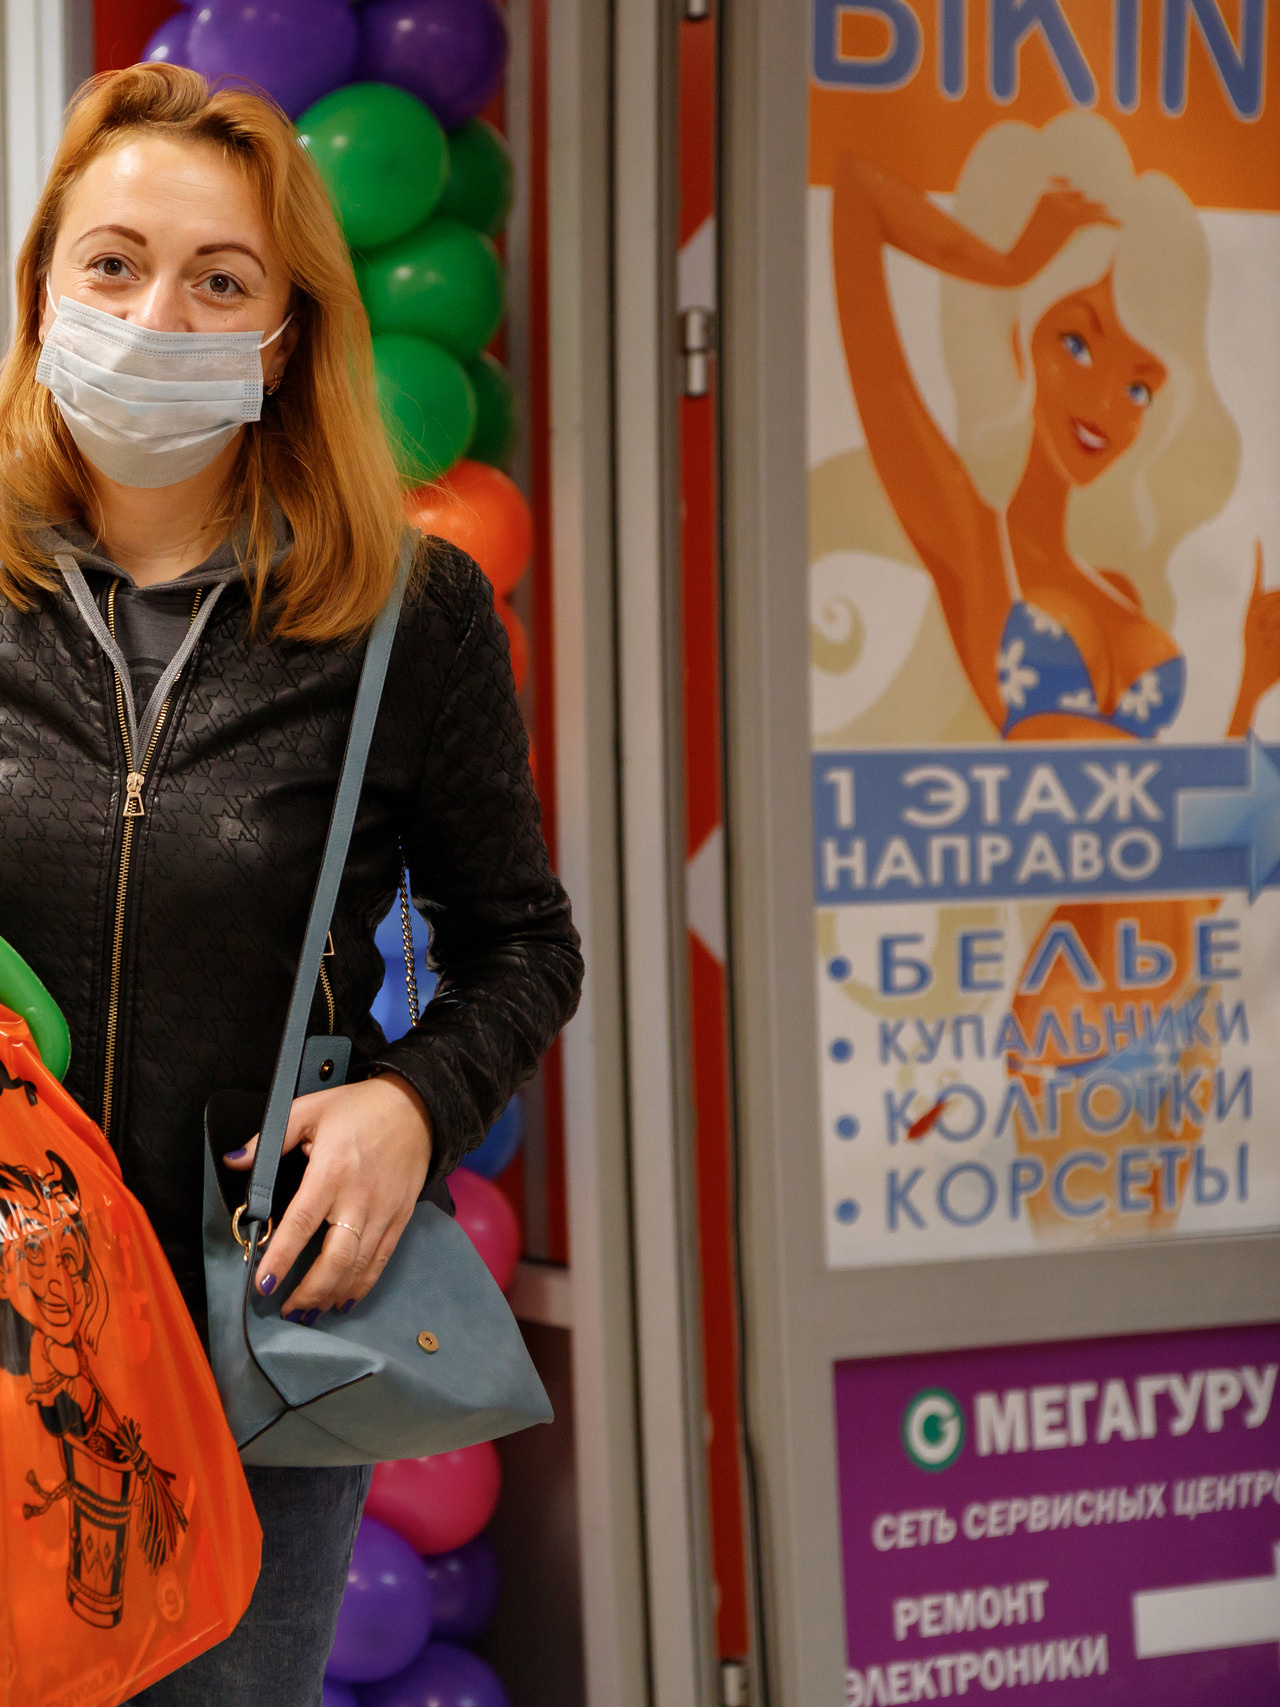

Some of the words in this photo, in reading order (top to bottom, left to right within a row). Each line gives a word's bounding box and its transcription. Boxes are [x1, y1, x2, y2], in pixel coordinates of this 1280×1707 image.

[824, 767, 856, 829] 1
[901, 761, 1163, 828] ЭТАЖ
[823, 828, 1162, 890] НАПРАВО
[877, 917, 1242, 997] БЕЛЬЕ
[878, 1000, 1250, 1066] КУПАЛЬНИКИ
[883, 1066, 1253, 1146] КОЛГОТКИ
[885, 1142, 1250, 1233] КОРСЕТЫ
[974, 1362, 1279, 1457] МЕГАГУРУ
[871, 1507, 958, 1552] СЕТЬ
[962, 1481, 1168, 1540] СЕРВИСНЫХ
[892, 1578, 1050, 1642] РЕМОНТ
[844, 1632, 1109, 1707] ЭЛЕКТРОНИКИ
